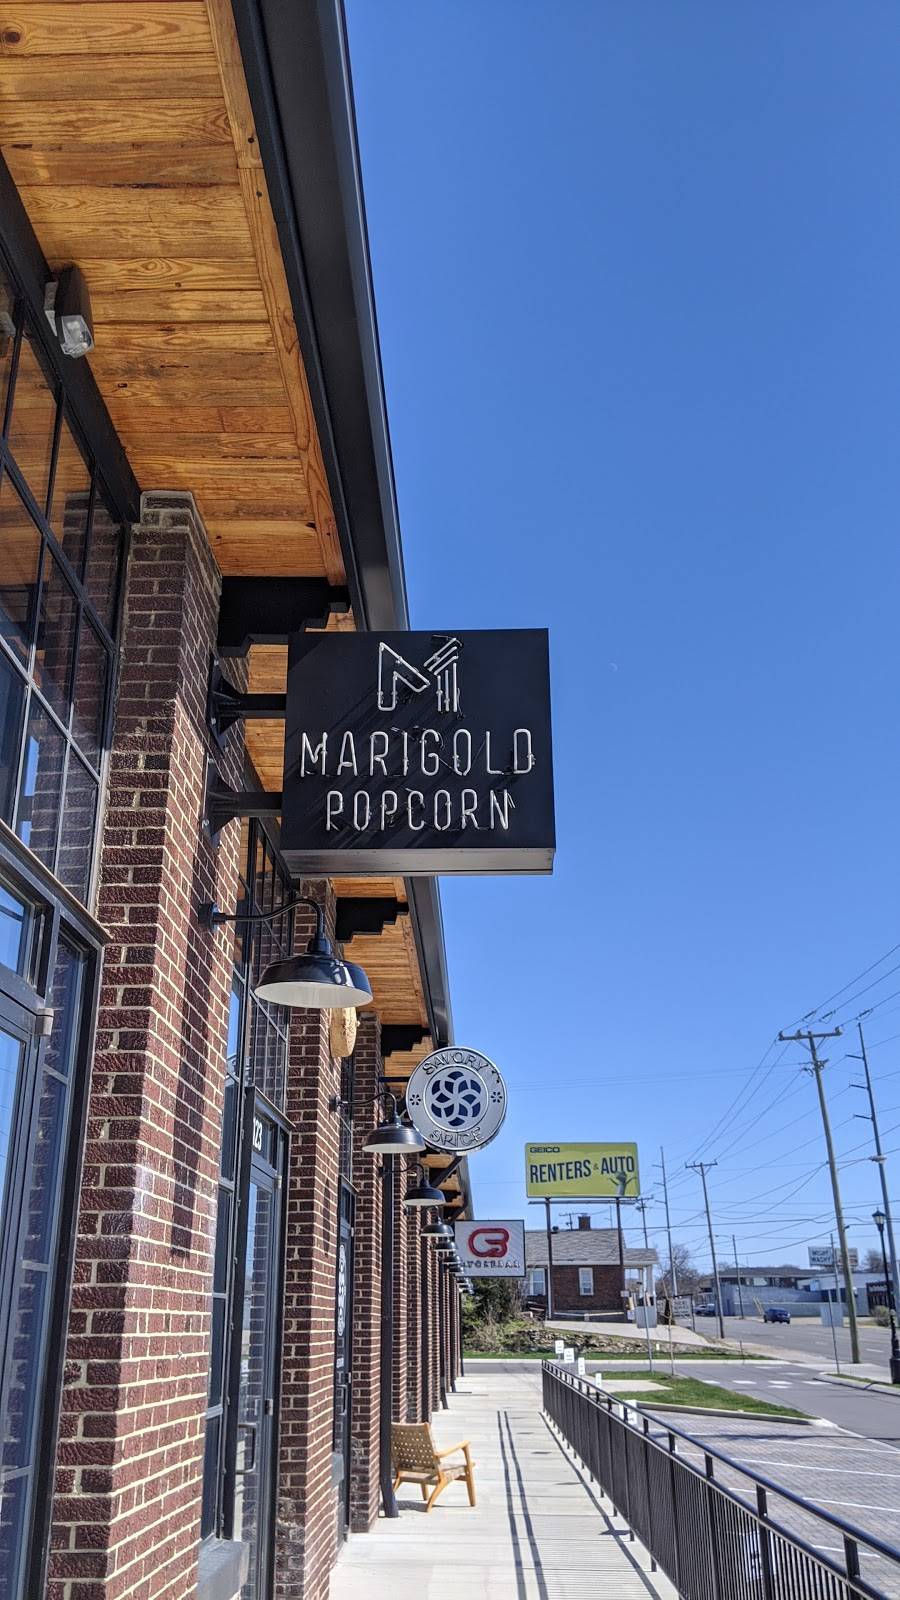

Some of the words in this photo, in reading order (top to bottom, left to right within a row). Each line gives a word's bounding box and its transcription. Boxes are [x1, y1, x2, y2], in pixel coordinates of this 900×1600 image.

[300, 728, 533, 778] MARIGOLD
[326, 788, 510, 832] POPCORN
[422, 1052, 489, 1075] SAVORY
[429, 1127, 482, 1147] SPICE
[530, 1159, 592, 1184] RENTERS
[600, 1156, 635, 1175] AUTO
